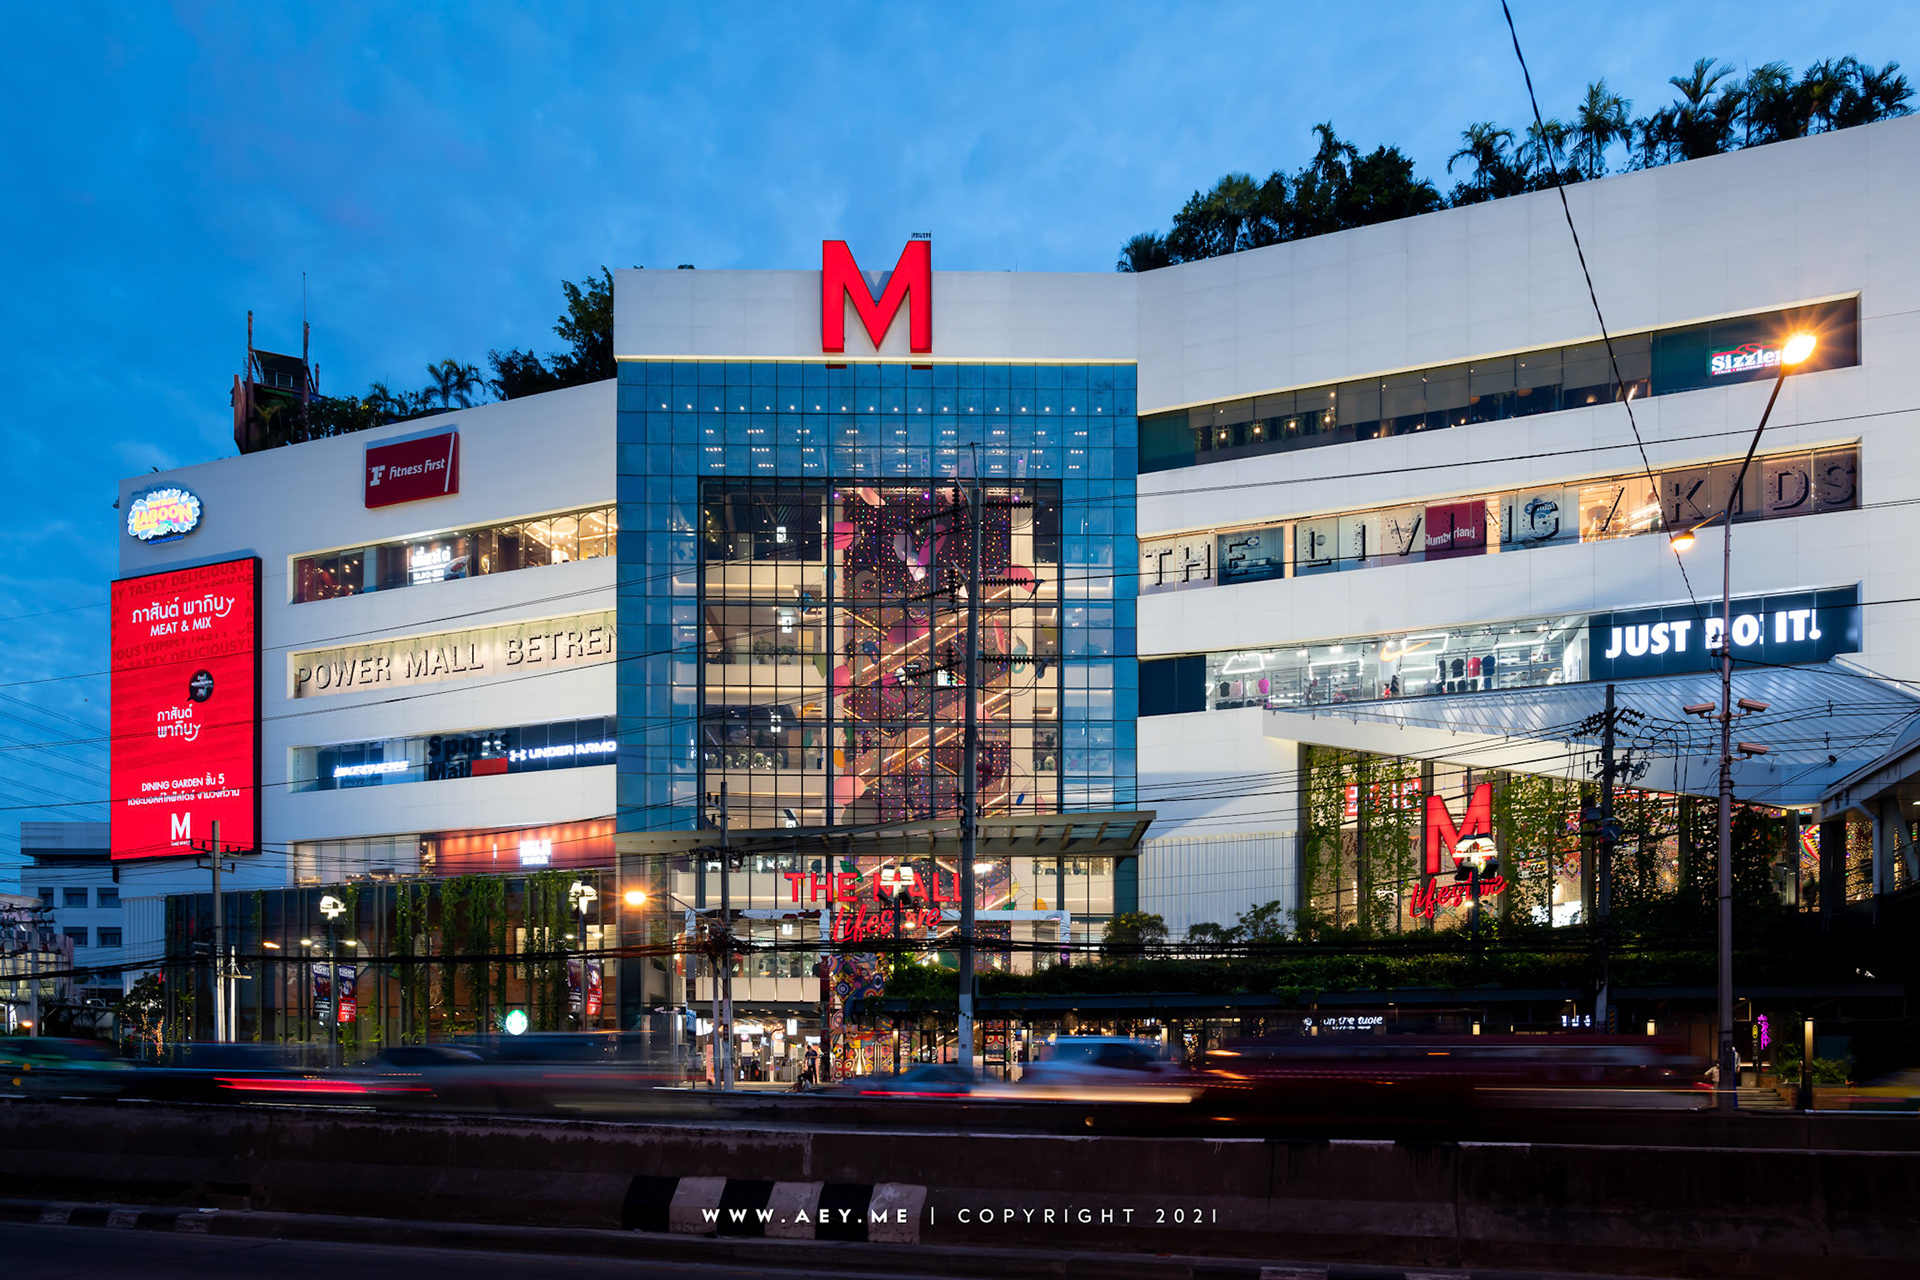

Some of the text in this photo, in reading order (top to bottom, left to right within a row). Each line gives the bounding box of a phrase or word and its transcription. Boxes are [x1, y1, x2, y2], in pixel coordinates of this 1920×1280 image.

[822, 240, 932, 353] M
[1711, 349, 1782, 371] Sizzler
[424, 457, 446, 474] First
[1666, 462, 1859, 524] KIDS
[134, 502, 194, 532] LAGOON
[150, 616, 212, 637] MEAT & MIX
[1605, 620, 1691, 659] JUST
[298, 655, 391, 690] POWER
[404, 642, 485, 679] MALL
[528, 745, 575, 760] UNDER
[141, 780, 170, 792] DINING
[171, 777, 204, 789] GARDEN
[218, 773, 225, 785] 5
[171, 812, 191, 841] M
[1426, 783, 1493, 875] M
[784, 872, 962, 902] THE MALL
